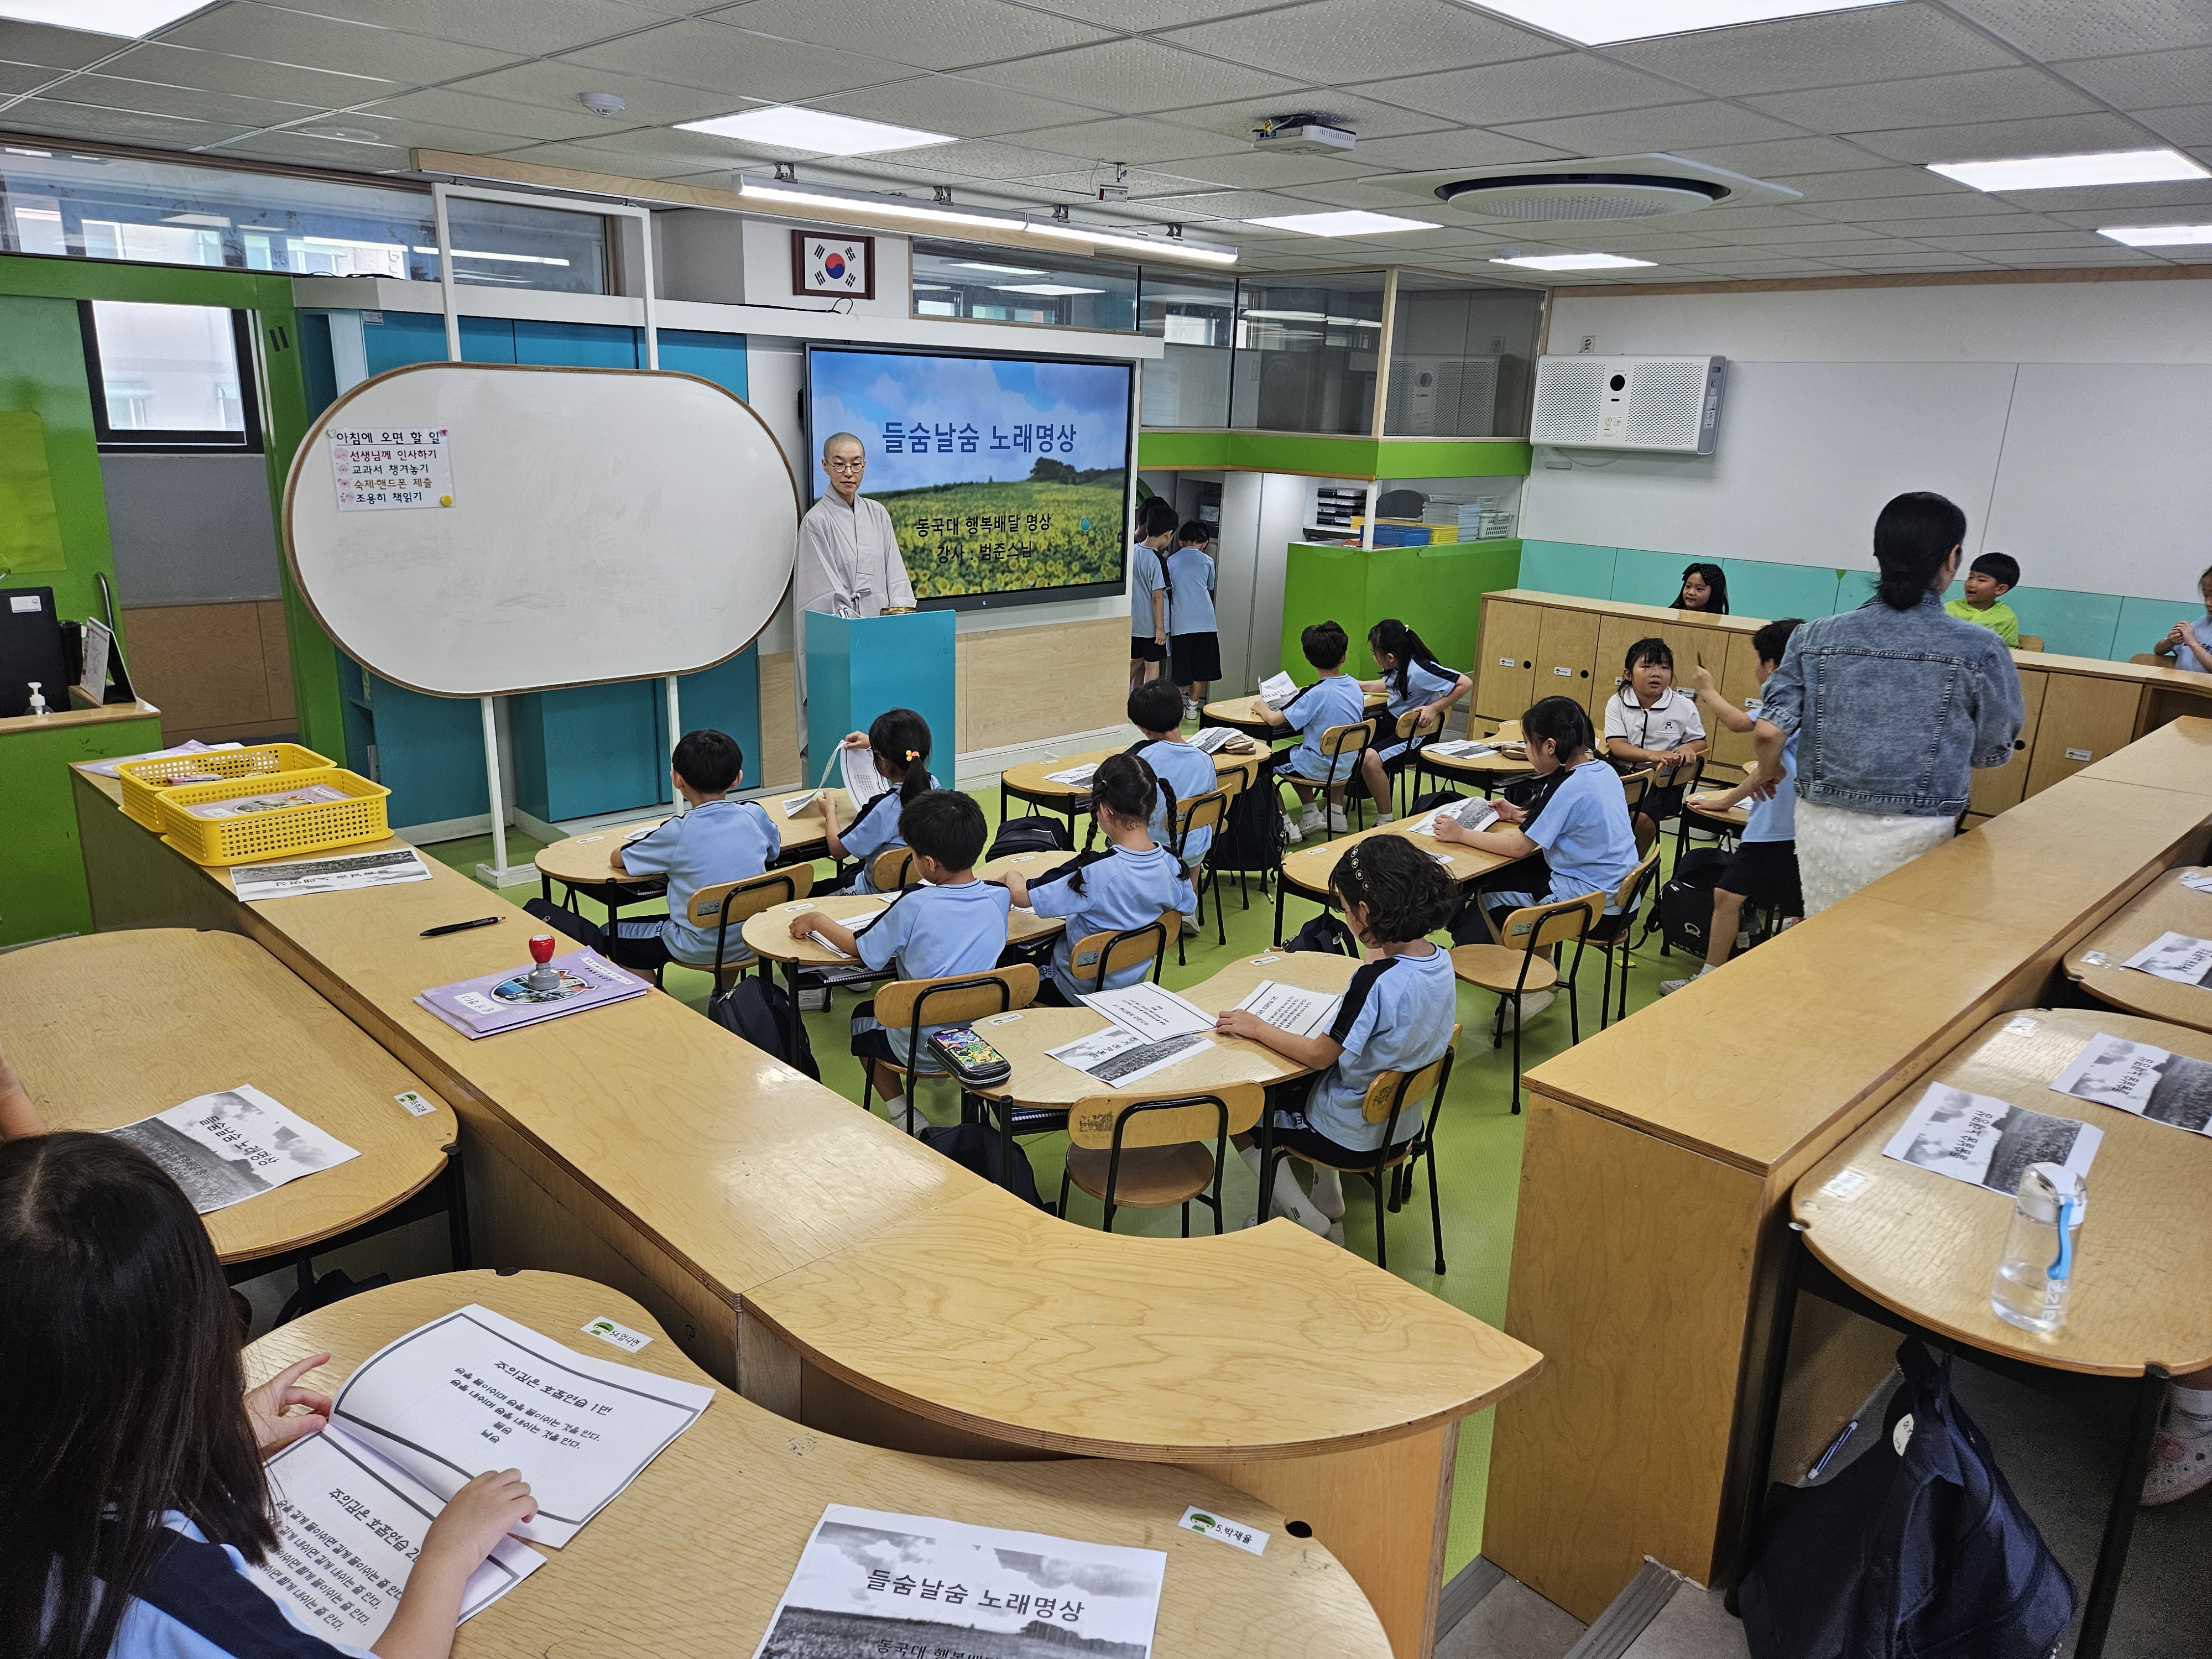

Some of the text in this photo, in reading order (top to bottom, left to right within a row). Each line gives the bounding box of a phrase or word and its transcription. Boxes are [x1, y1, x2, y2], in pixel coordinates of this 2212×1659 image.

[336, 431, 440, 445] 아침에 오면 할 일
[882, 421, 1077, 453] 들숨날숨 노래명상
[350, 450, 437, 462] 선생님께 인사하기
[352, 464, 429, 476] 교과서 챙겨놓기
[356, 492, 422, 504] 조용히 책읽기
[413, 477, 432, 488] 제출
[916, 513, 1051, 538] 동국대 행복배달 명상
[937, 545, 964, 564] 강사
[979, 541, 1032, 562] 범준스님
[2111, 1056, 2154, 1095] 들숨날숨 노래명상
[200, 1115, 279, 1166] 들숨날숨 노래명상
[1949, 1110, 1992, 1160] 들숨날숨 노래명상
[454, 1368, 600, 1442] 숨을 들이쉬며 숨을 들이쉬는 것을 안다.
[494, 1360, 613, 1416] 주의깊은 호흡연습 1번
[450, 1379, 580, 1449] 숨을 내쉬며 숨을 내쉬는 것을 안다.
[493, 1421, 512, 1434] 들숨
[481, 1429, 500, 1443] 날숨
[329, 1488, 371, 1521] 주의깊은
[366, 1518, 409, 1552] 호흡연습
[1215, 1524, 1252, 1545] 5.박재율
[290, 1510, 311, 1525] 길게
[304, 1522, 339, 1547] 들이쉬면
[332, 1543, 353, 1559] 길게
[347, 1556, 380, 1582] 들이쉬는
[376, 1578, 392, 1589] 줄
[294, 1538, 321, 1558] 내쉬면
[314, 1554, 335, 1570] 길게
[330, 1567, 355, 1588] 내쉬는
[351, 1584, 367, 1595] 줄
[361, 1592, 382, 1609] 안다.
[276, 1575, 298, 1592] 짧게
[293, 1589, 319, 1610] 내쉬는
[314, 1606, 330, 1616] 줄
[323, 1614, 345, 1631] 안다.
[295, 1565, 317, 1581] 짧게
[311, 1578, 344, 1604] 들이쉬는
[340, 1601, 355, 1611] 줄
[349, 1608, 371, 1626] 안다.
[867, 1569, 1084, 1622] 들숨날숨 노래명상
[877, 1639, 927, 1659] 동국대
